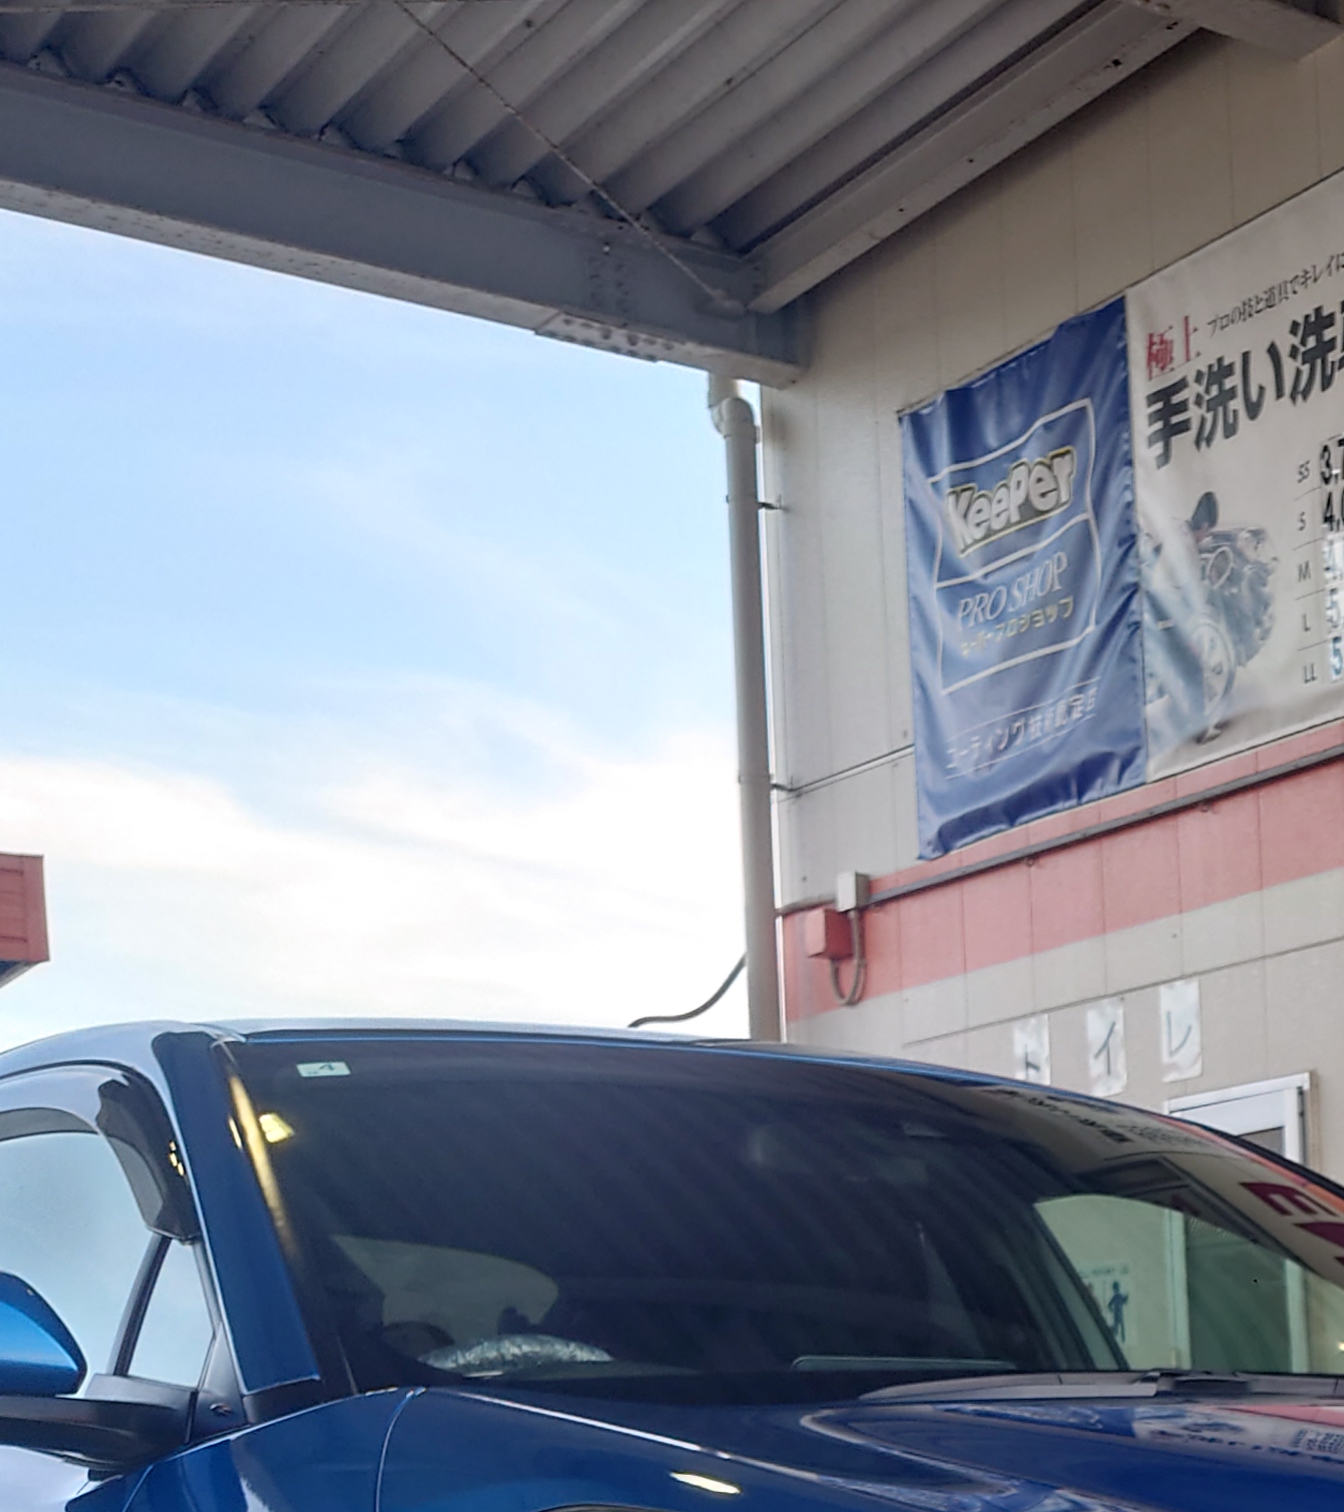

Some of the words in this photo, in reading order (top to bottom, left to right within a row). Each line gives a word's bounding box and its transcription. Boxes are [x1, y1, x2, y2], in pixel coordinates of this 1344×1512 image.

[1146, 315, 1201, 381] 極上
[947, 448, 1077, 553] KeePer
[957, 586, 1007, 630] PRO
[1008, 551, 1069, 612] SHOP
[1023, 1010, 1194, 1080] トイレ
